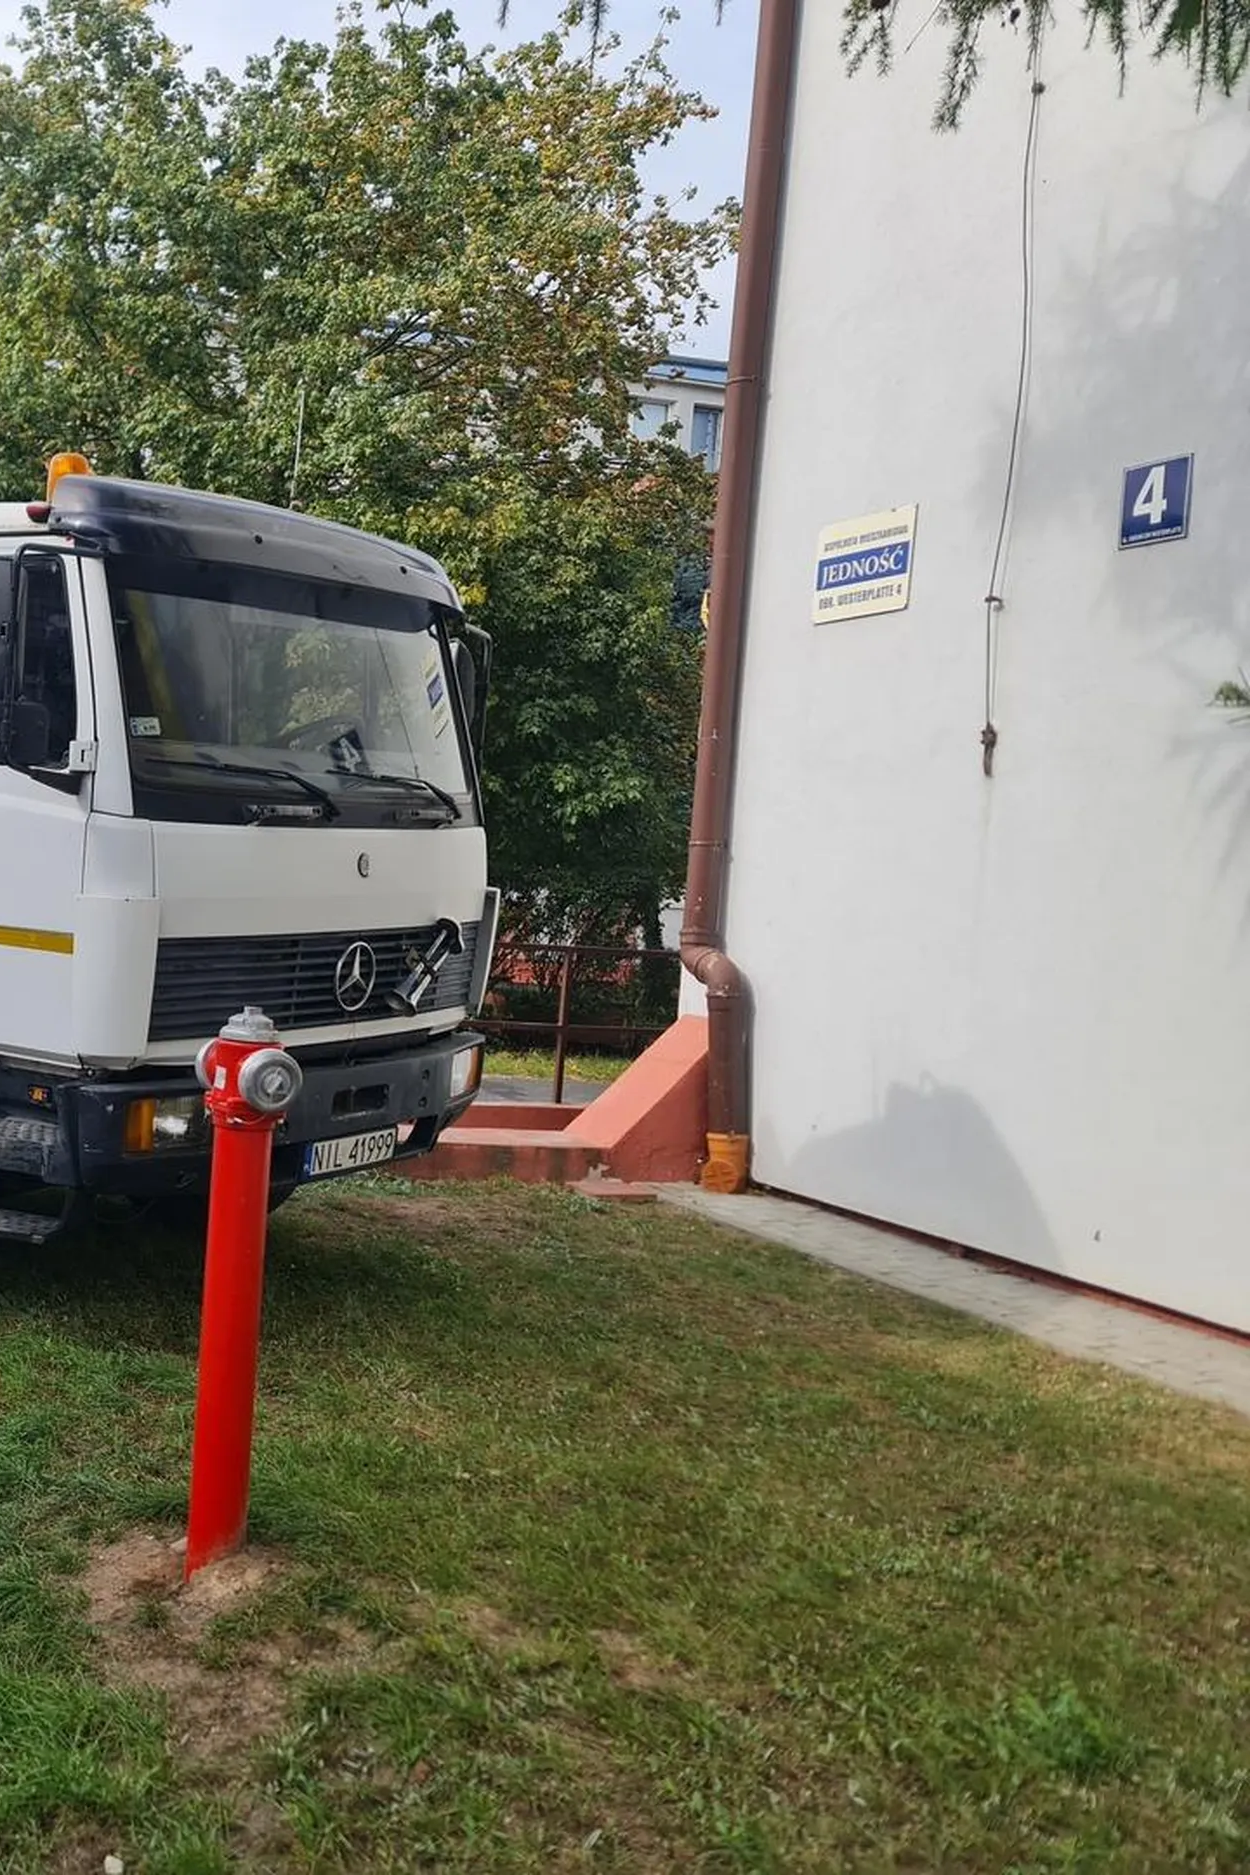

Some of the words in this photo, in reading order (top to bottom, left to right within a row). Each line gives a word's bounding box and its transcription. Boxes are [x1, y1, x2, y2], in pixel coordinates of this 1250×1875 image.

[1133, 464, 1167, 524] 4
[821, 545, 904, 588] JEDNOŚĆ
[312, 1142, 342, 1172] NIL
[349, 1132, 393, 1164] 41999
